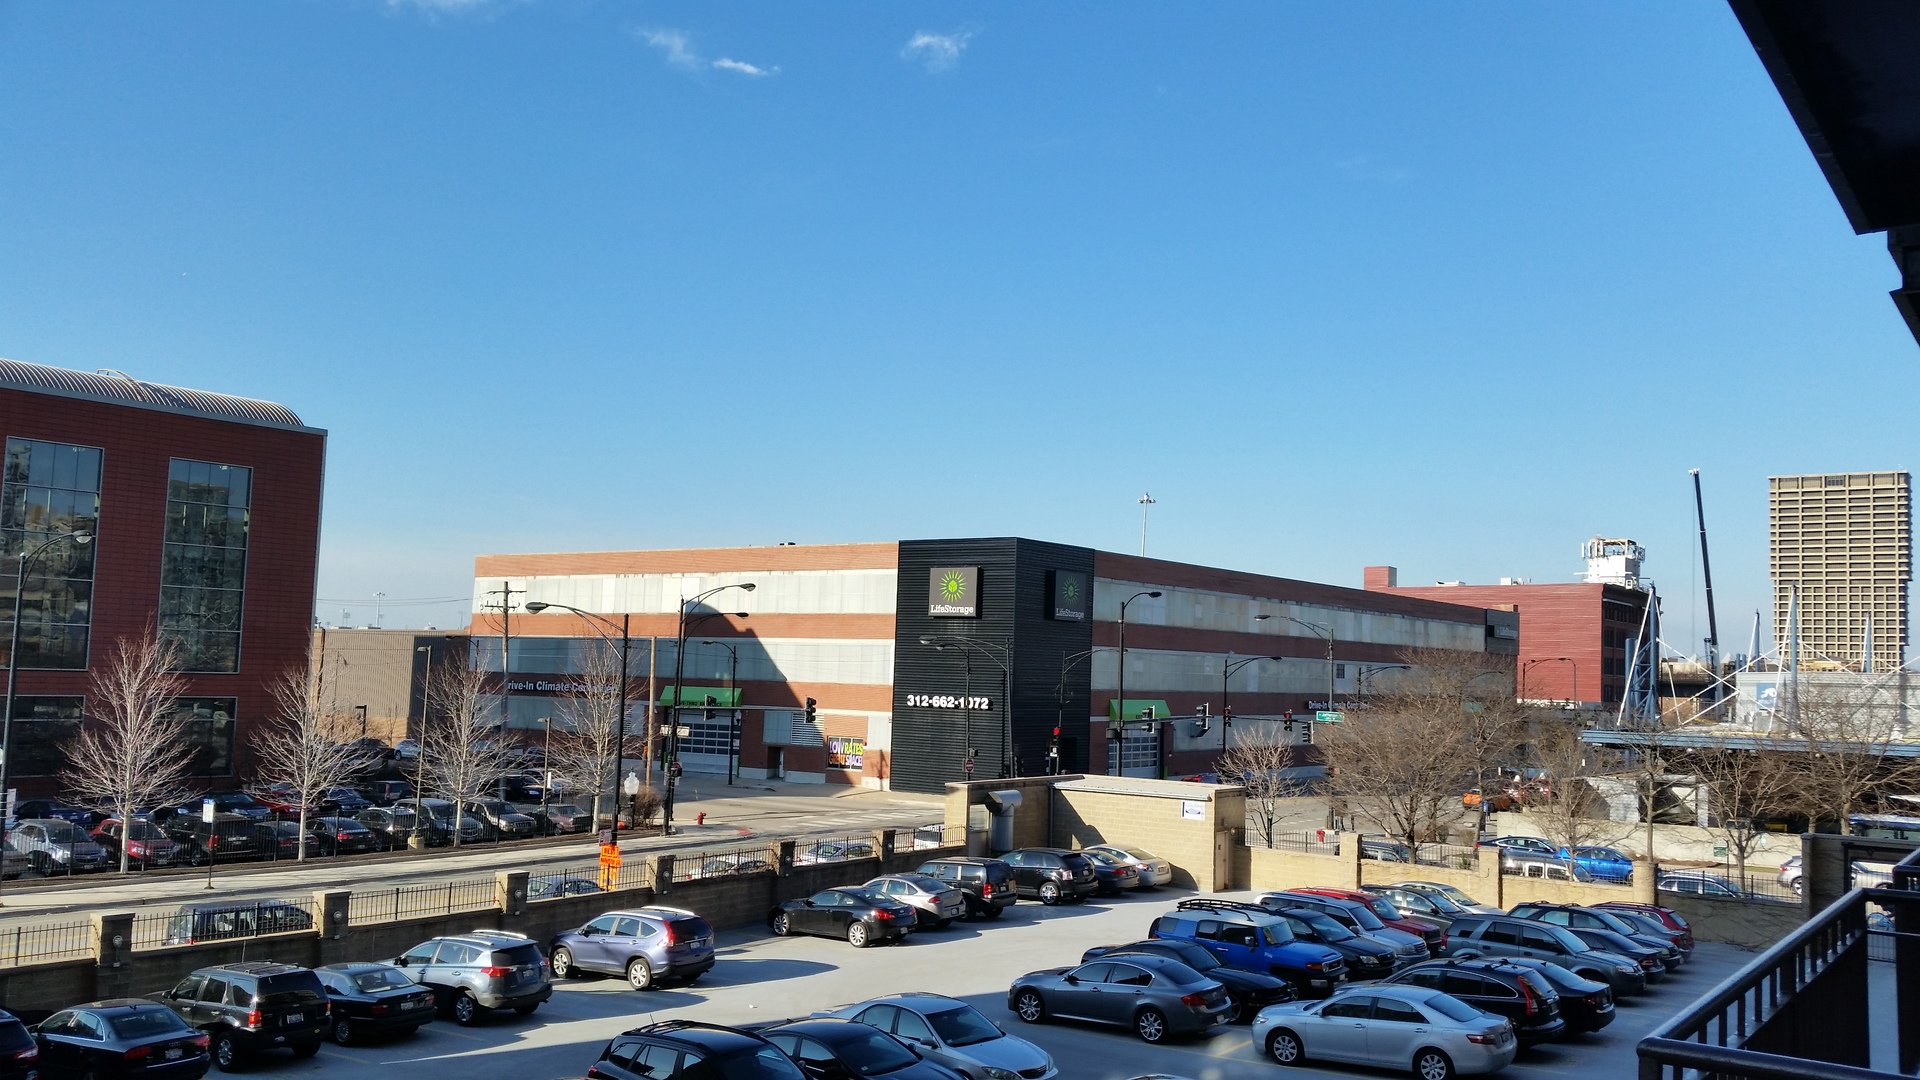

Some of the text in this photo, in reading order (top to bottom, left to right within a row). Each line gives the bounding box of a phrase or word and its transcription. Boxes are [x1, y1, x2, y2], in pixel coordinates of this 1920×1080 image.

[930, 604, 974, 615] LifeStorage
[1056, 608, 1084, 619] LifeStorage
[503, 680, 534, 691] rive-In
[536, 681, 570, 693] Climate
[907, 694, 989, 709] 312-662-1072
